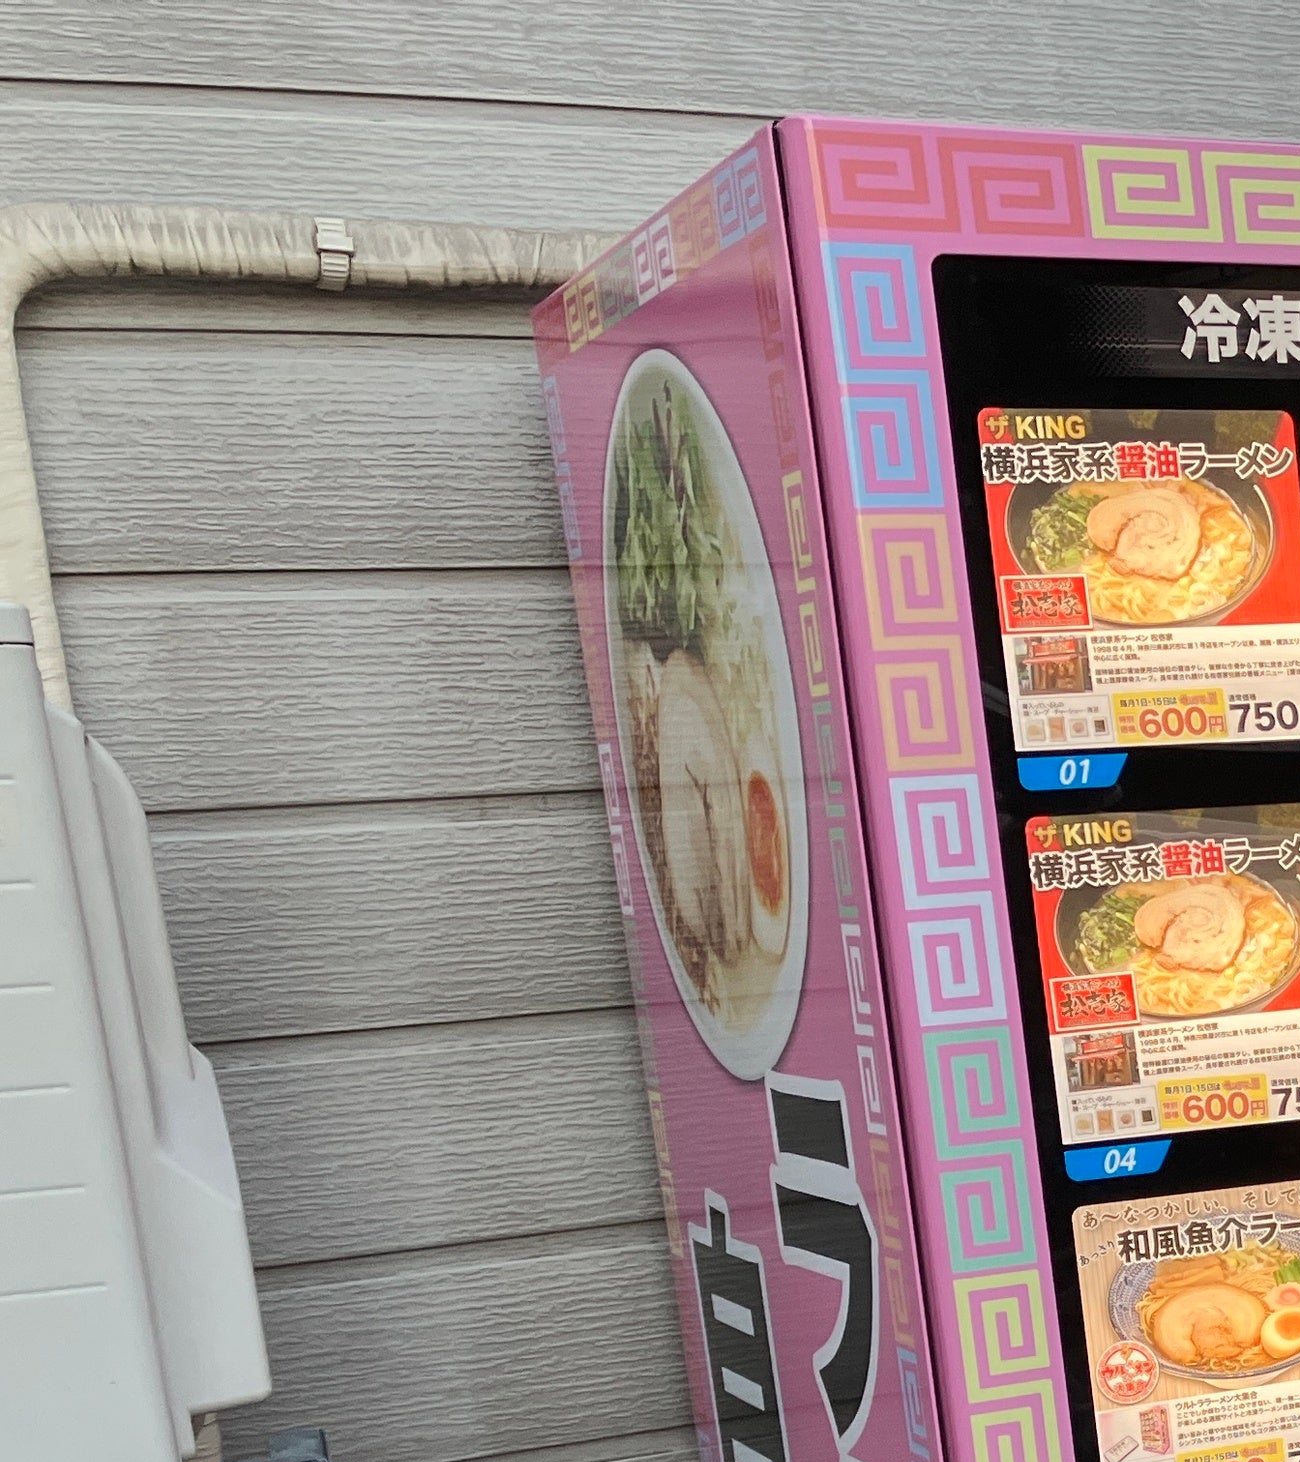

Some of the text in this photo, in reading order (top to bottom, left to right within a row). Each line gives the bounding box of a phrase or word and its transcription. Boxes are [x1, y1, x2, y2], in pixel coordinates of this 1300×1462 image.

[986, 416, 1086, 440] ザ KING
[982, 443, 1292, 483] 横浜家系醤油ラーメン
[1139, 707, 1226, 738] 600円
[1059, 759, 1091, 785] 01
[1034, 819, 1132, 847] ザ KING
[1183, 1091, 1266, 1123] 600円
[1104, 1148, 1137, 1173] 04
